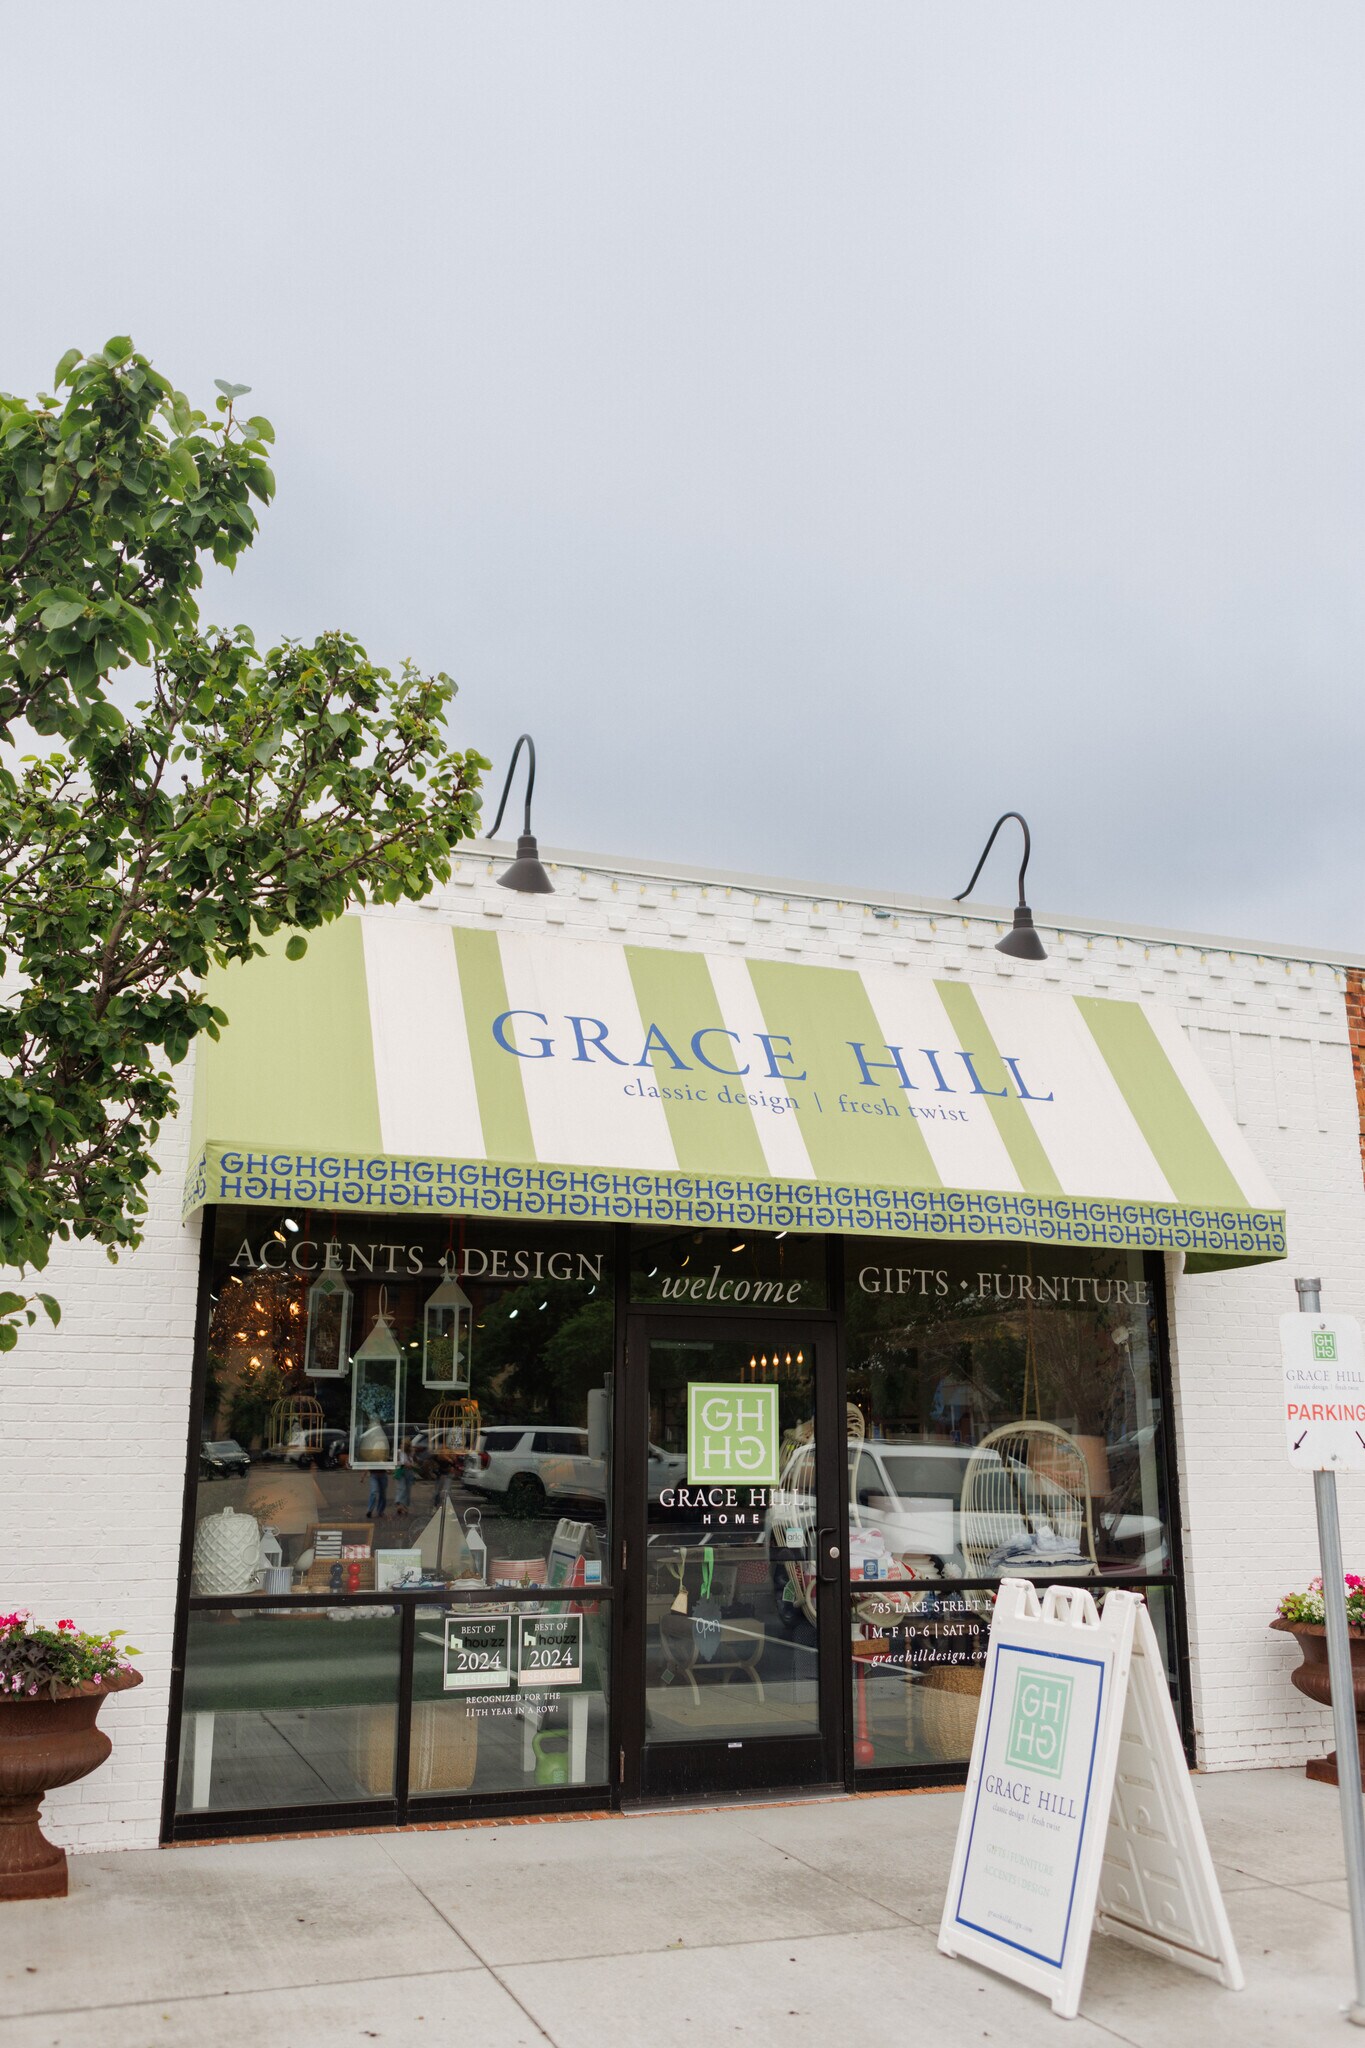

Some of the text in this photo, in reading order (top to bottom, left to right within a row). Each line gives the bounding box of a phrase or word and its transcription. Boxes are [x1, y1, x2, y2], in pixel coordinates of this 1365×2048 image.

[492, 1010, 1054, 1101] GRACE HILL
[623, 1078, 708, 1102] classic
[717, 1085, 801, 1115] design
[838, 1093, 900, 1117] fresh
[907, 1104, 970, 1122] twist
[229, 1238, 604, 1281] ACCENTS DESIGN
[660, 1265, 802, 1303] welcome
[858, 1266, 1150, 1306] GIFTS FURNITURE
[1286, 1369, 1365, 1383] GRACE HILL
[700, 1397, 765, 1432] GH
[1287, 1403, 1365, 1421] PARKING
[659, 1488, 805, 1508] GRACE HILL
[703, 1513, 760, 1525] HOME
[787, 1532, 803, 1541] arlo
[871, 1602, 891, 1614] 785
[895, 1601, 929, 1613] LAKE
[933, 1599, 981, 1613] STREET
[461, 1625, 496, 1634] BEST OF
[534, 1622, 568, 1631] BEST OF
[695, 1617, 721, 1639] Open
[904, 1625, 930, 1637] 10-6
[943, 1625, 965, 1637] SAT
[464, 1636, 505, 1648] houzz
[538, 1633, 578, 1645] houzz
[457, 1650, 502, 1671] 2024
[529, 1647, 573, 1668] 2024
[455, 1673, 499, 1684] DESIGN
[527, 1669, 574, 1681] SERVICE
[466, 1692, 561, 1705] RECOGNIZED FOR THE
[1020, 1683, 1062, 1724] GH
[466, 1704, 559, 1717] 11TH YEAR IN A ROW!
[985, 1774, 1077, 1820] GRACE HILL
[992, 1802, 1008, 1815] classic
[1008, 1806, 1025, 1822] design
[1031, 1814, 1046, 1827] fresh
[1010, 1851, 1054, 1876] FURNITURE
